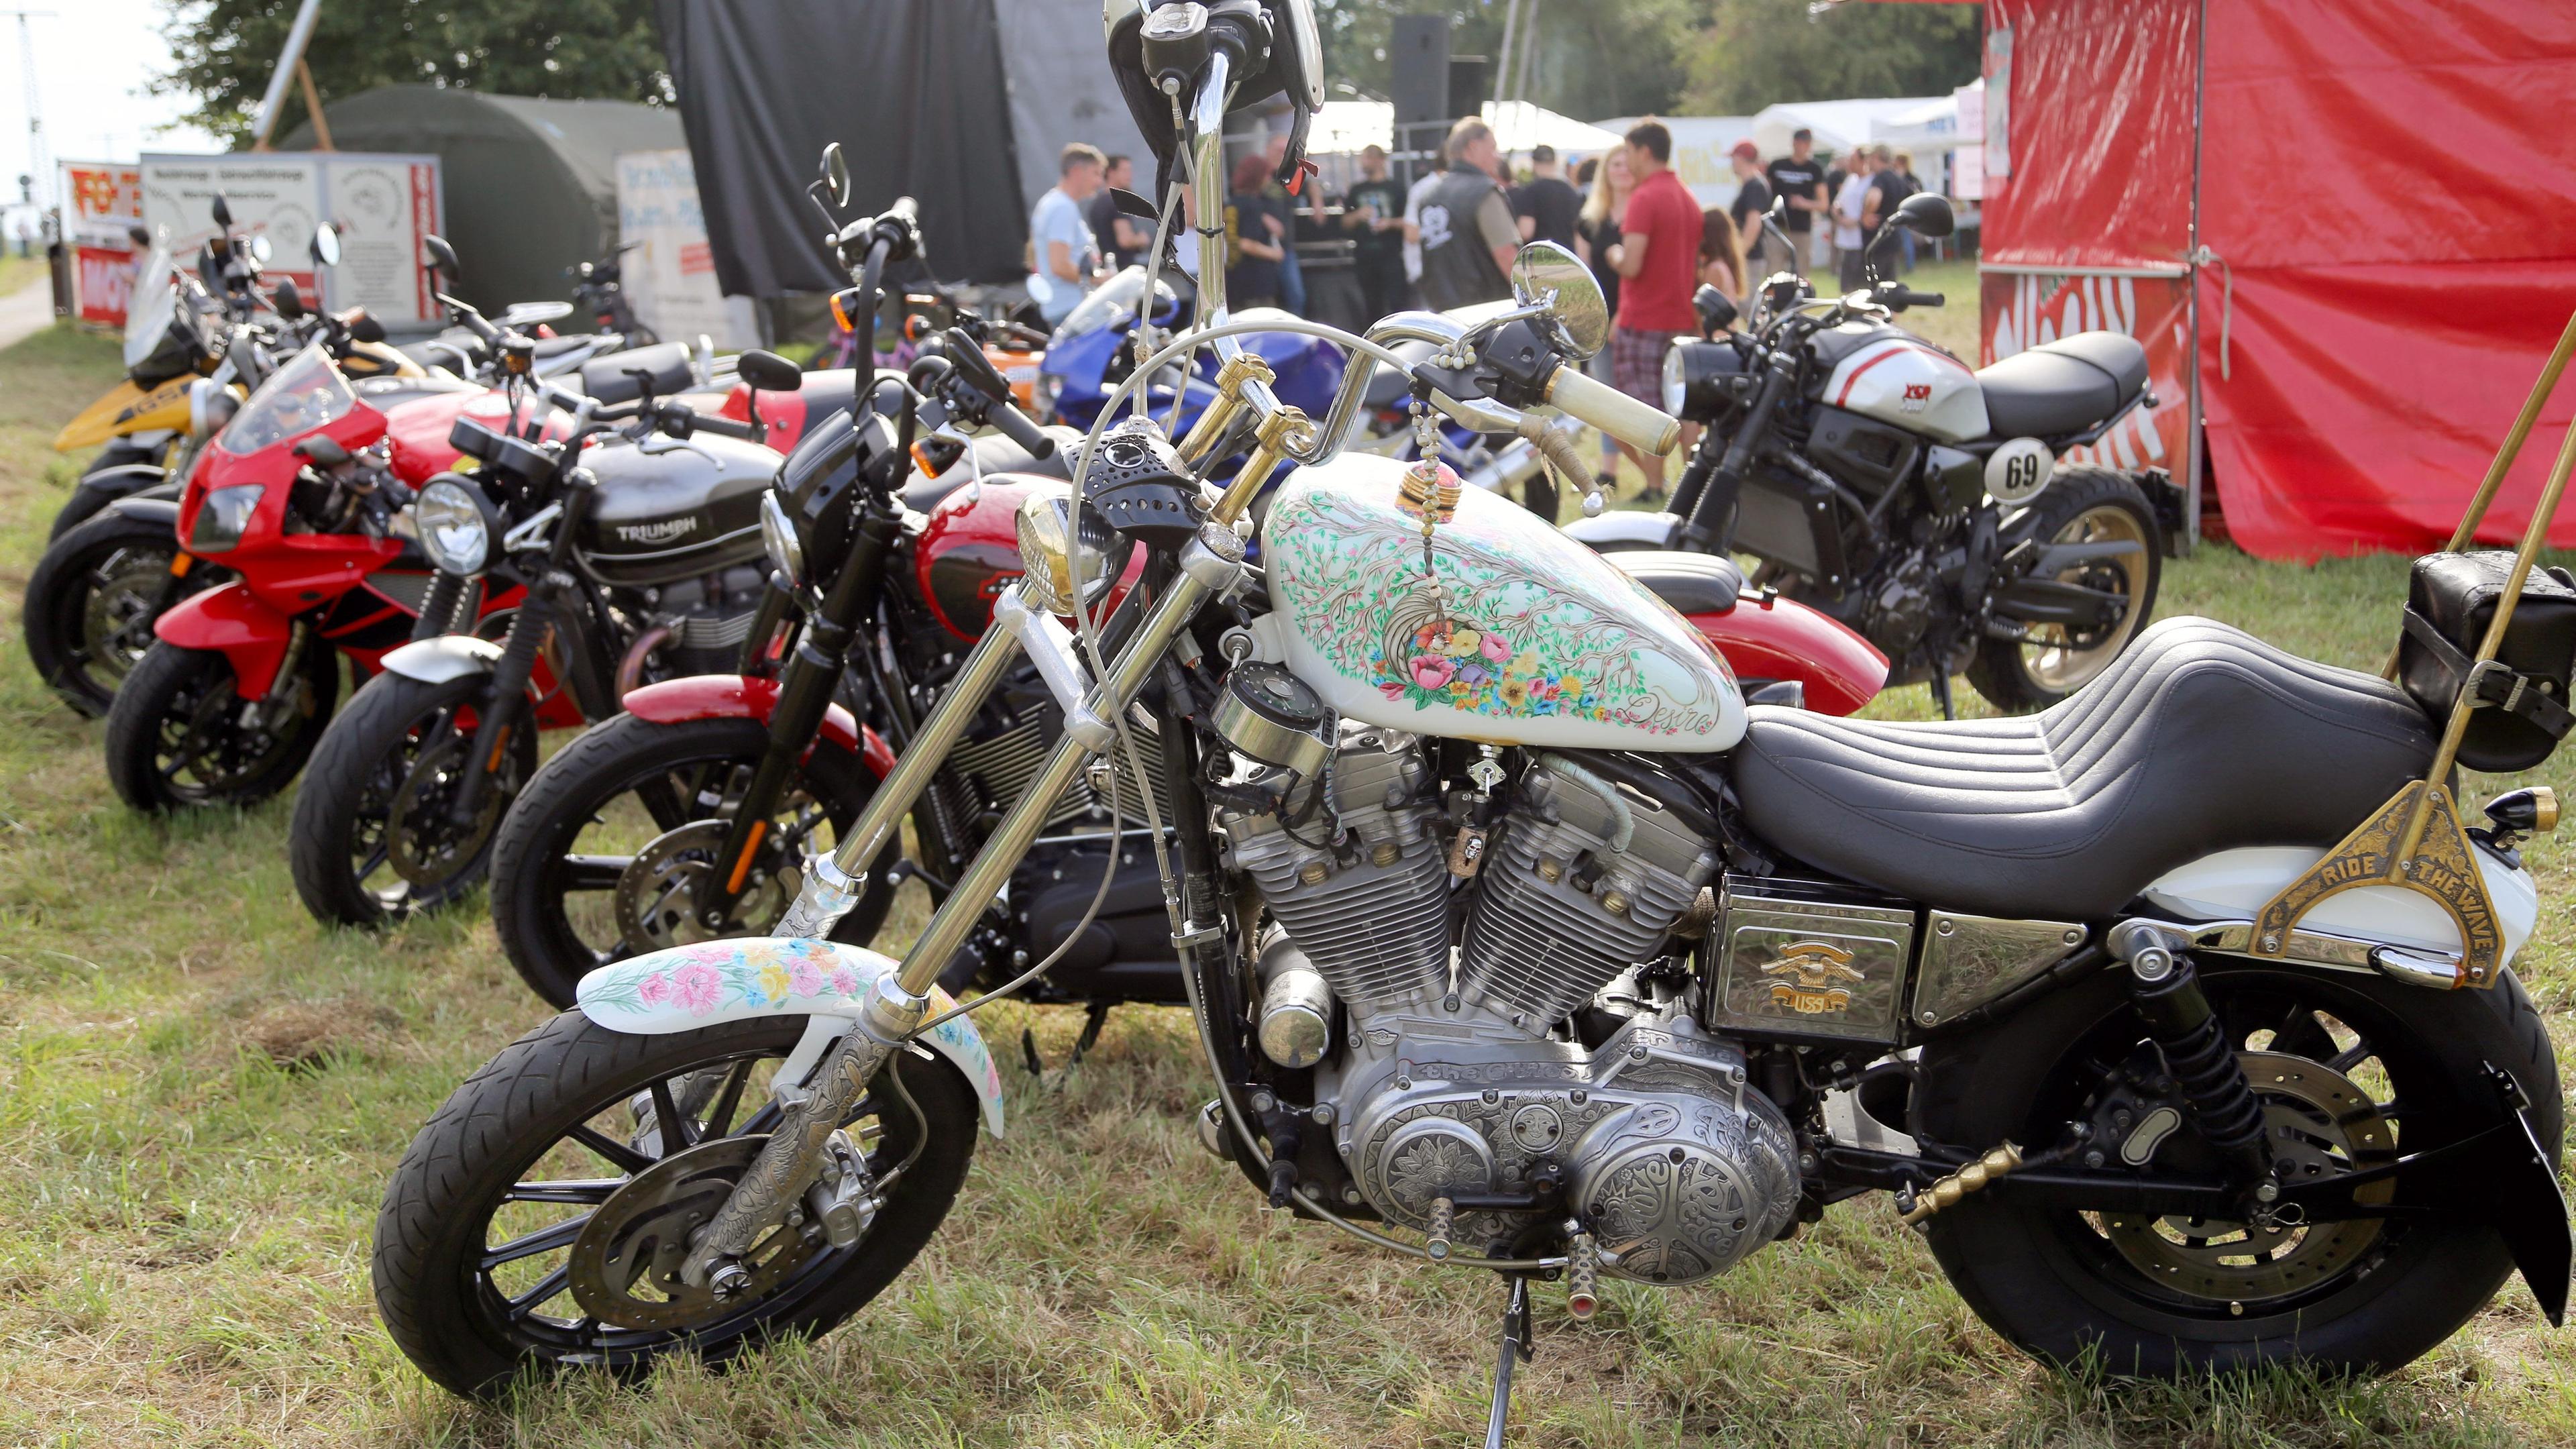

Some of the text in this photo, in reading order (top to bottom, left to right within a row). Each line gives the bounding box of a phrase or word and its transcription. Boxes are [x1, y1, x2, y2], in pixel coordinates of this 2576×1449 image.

[2006, 453, 2037, 489] 69
[616, 516, 697, 542] TRIUMPH
[1617, 692, 1711, 735] Desire
[2322, 856, 2495, 950] RIDE THE WAVE
[1794, 996, 1824, 1014] USA
[1420, 1064, 1481, 1079] the
